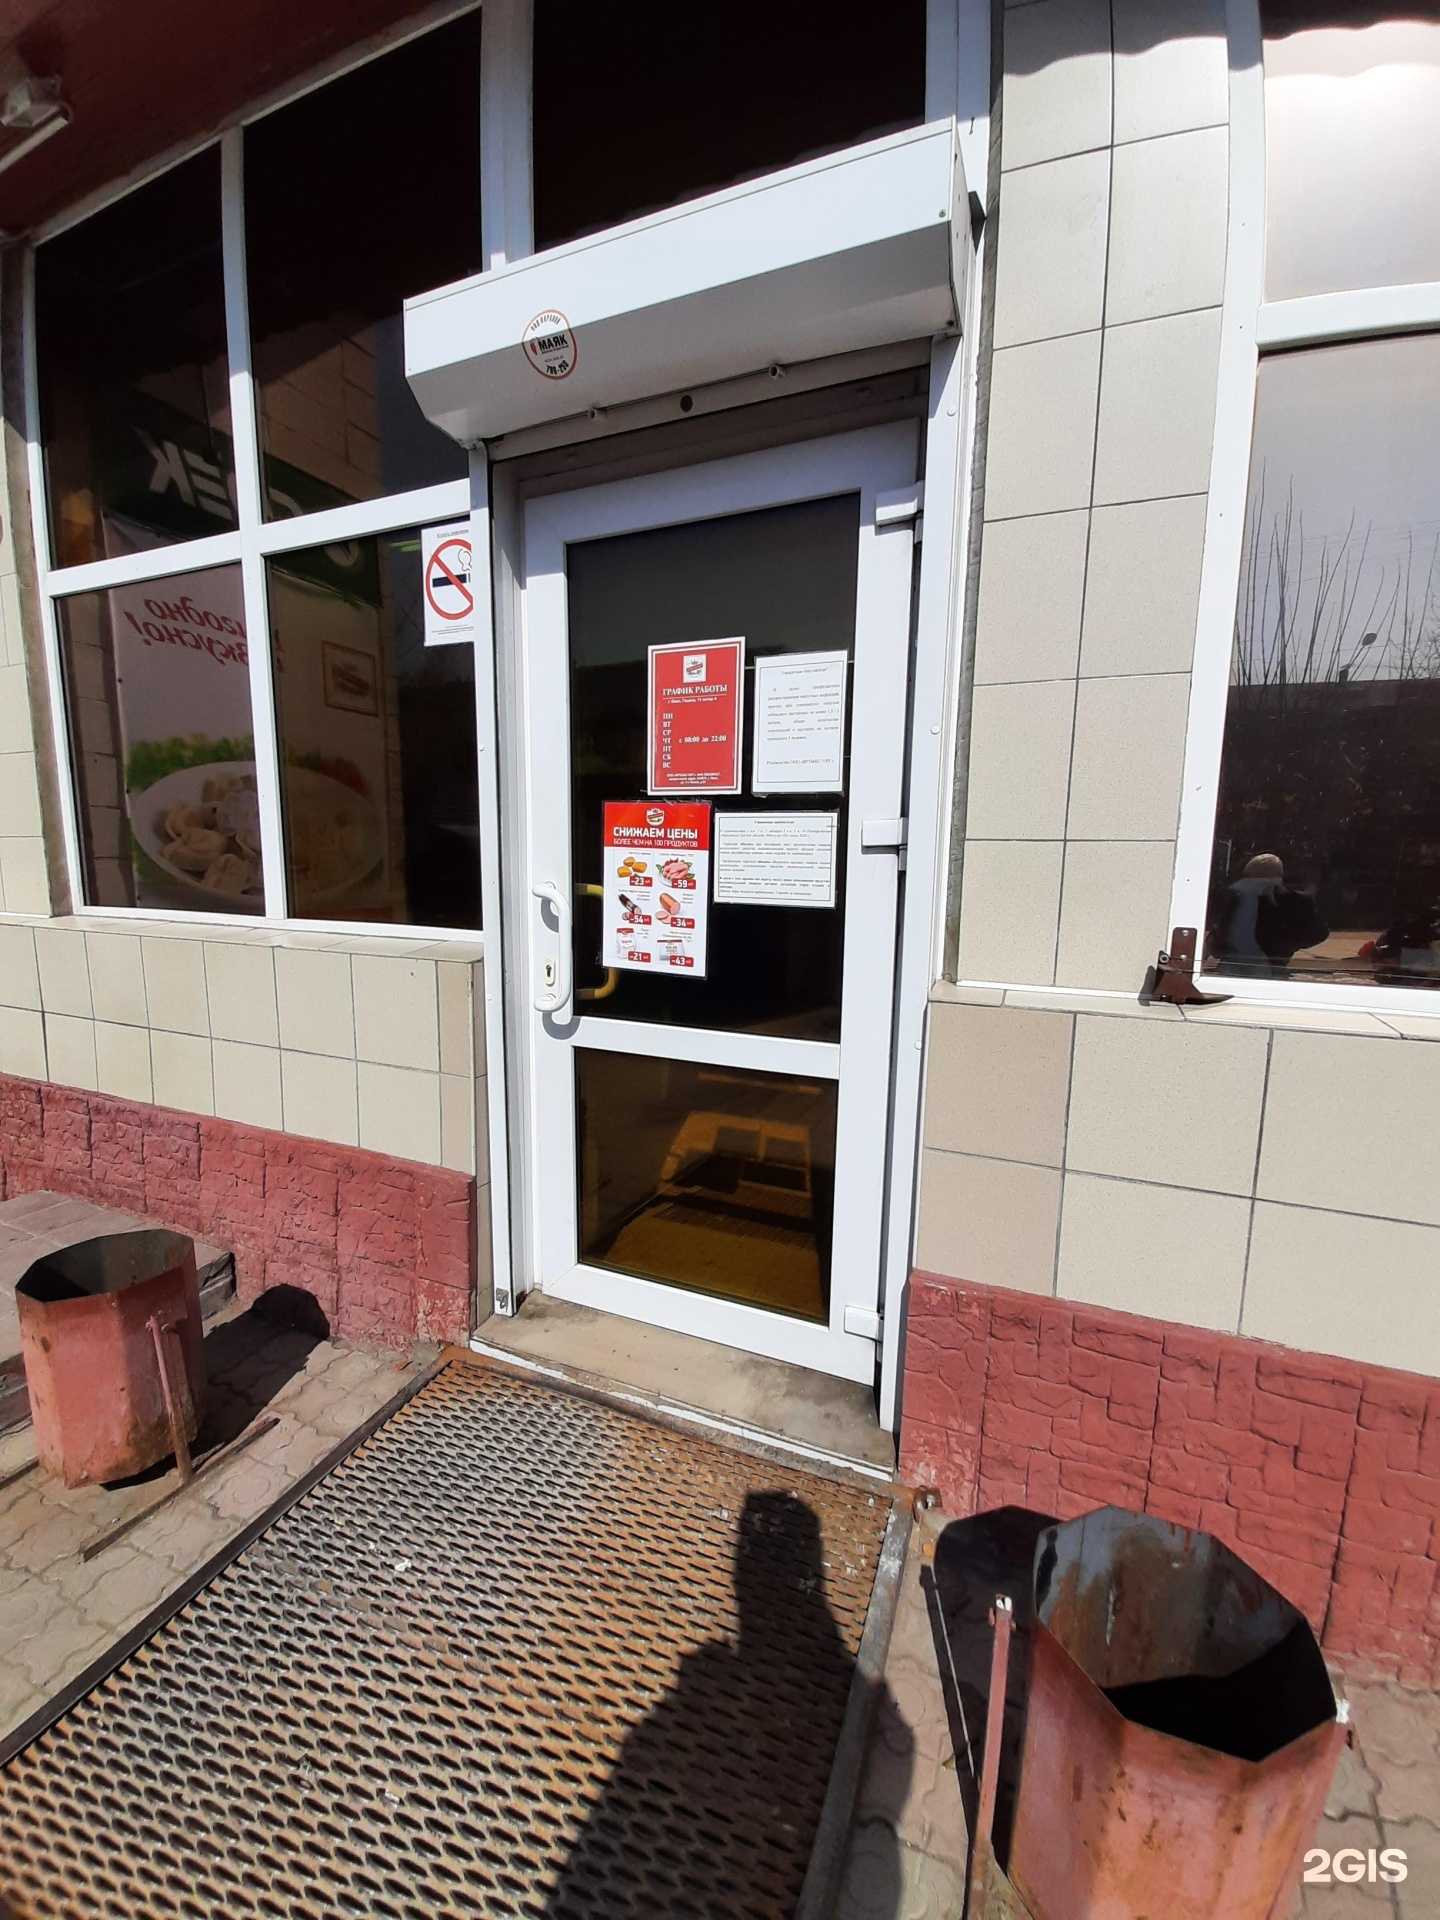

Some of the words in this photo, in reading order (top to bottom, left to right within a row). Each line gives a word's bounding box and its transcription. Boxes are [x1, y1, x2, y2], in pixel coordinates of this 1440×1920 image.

[538, 334, 568, 351] МАЯК
[662, 686, 694, 697] ГРАФИК
[695, 684, 728, 695] РАБОТЫ
[613, 826, 665, 838] СНИЖАЕМ
[667, 828, 698, 840] ЦЕНЫ
[613, 837, 632, 846] БОЛЕЕ
[632, 838, 644, 846] ЧЕМ
[644, 838, 654, 847] НА
[654, 839, 664, 847] 100
[664, 839, 698, 848] ПРОДУКТОВ
